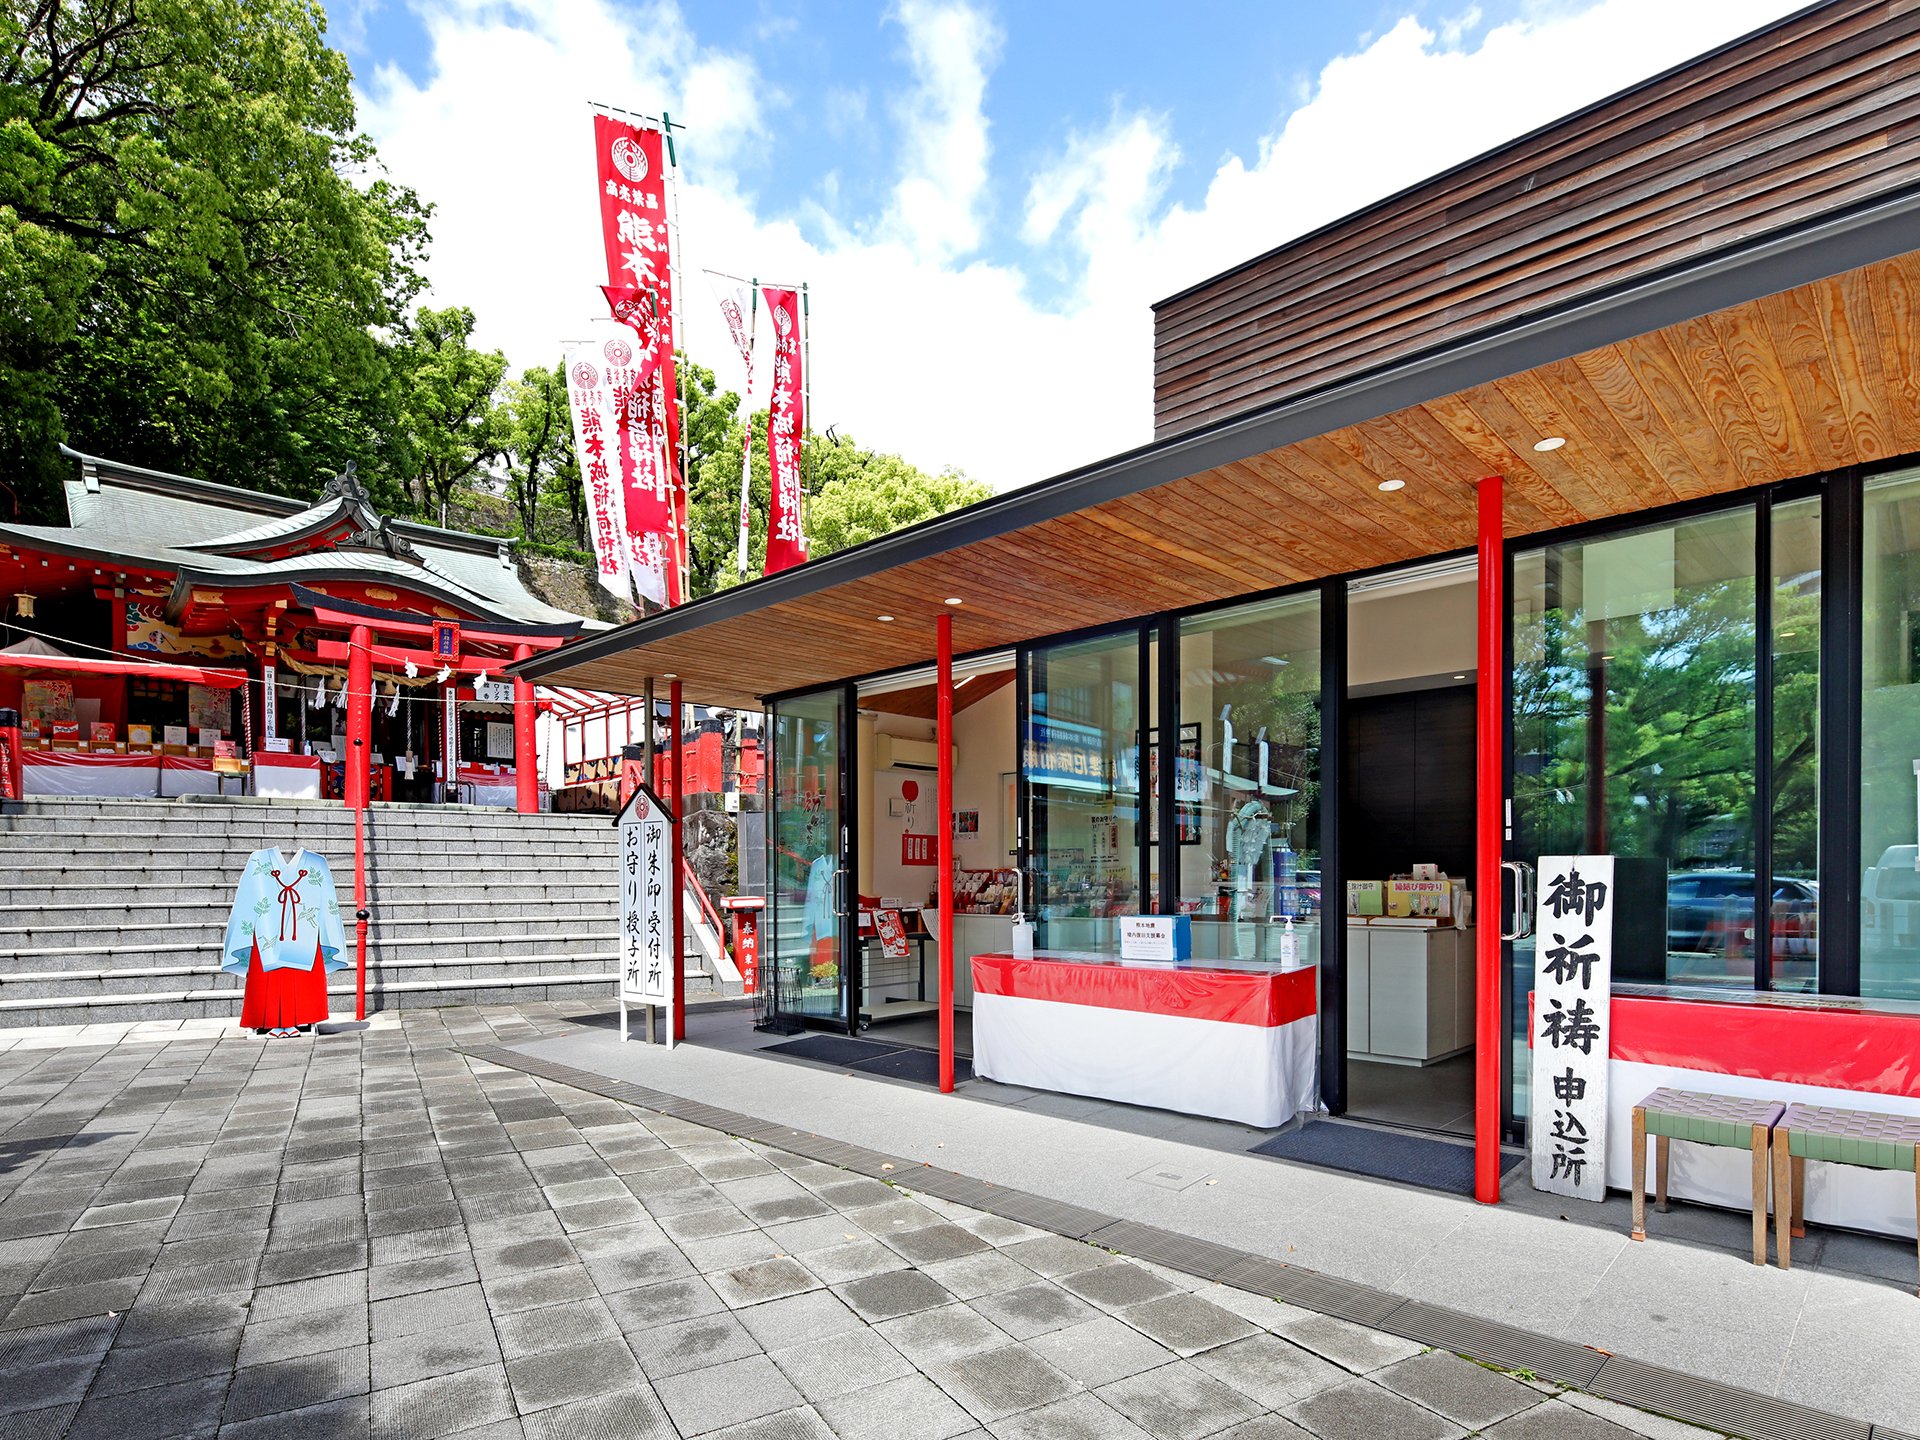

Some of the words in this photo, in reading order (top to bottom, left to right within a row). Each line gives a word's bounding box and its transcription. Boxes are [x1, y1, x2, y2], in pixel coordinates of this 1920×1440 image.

[605, 179, 658, 209] 商売繁昌
[659, 278, 671, 345] 初午大祭
[626, 826, 640, 987] お守り授与所
[646, 826, 661, 989] 御朱印受付所
[742, 921, 754, 949] 奉納
[1541, 871, 1607, 1187] 御祈祷申込所
